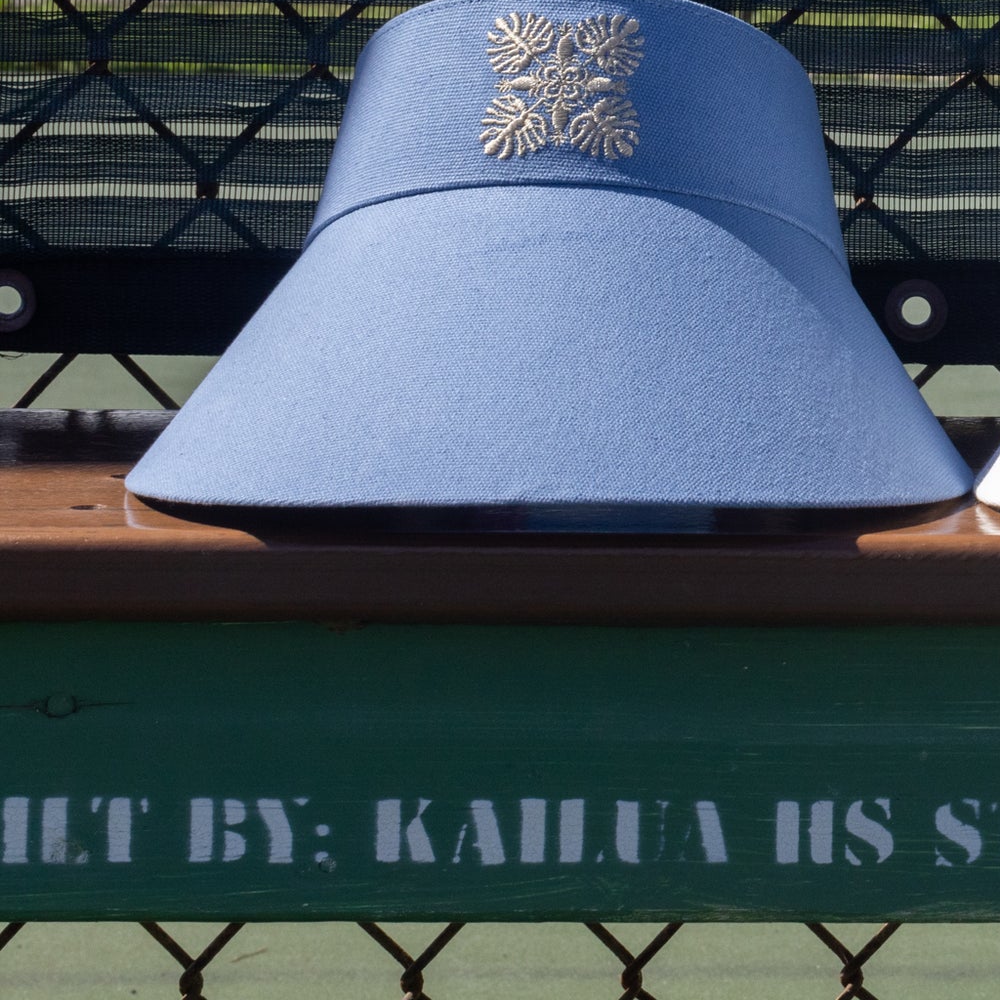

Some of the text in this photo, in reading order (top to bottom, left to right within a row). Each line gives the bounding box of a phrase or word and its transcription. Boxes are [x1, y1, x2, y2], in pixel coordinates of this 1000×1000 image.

[189, 798, 330, 864] BY:
[376, 799, 728, 864] KAILUA
[775, 799, 894, 865] HS
